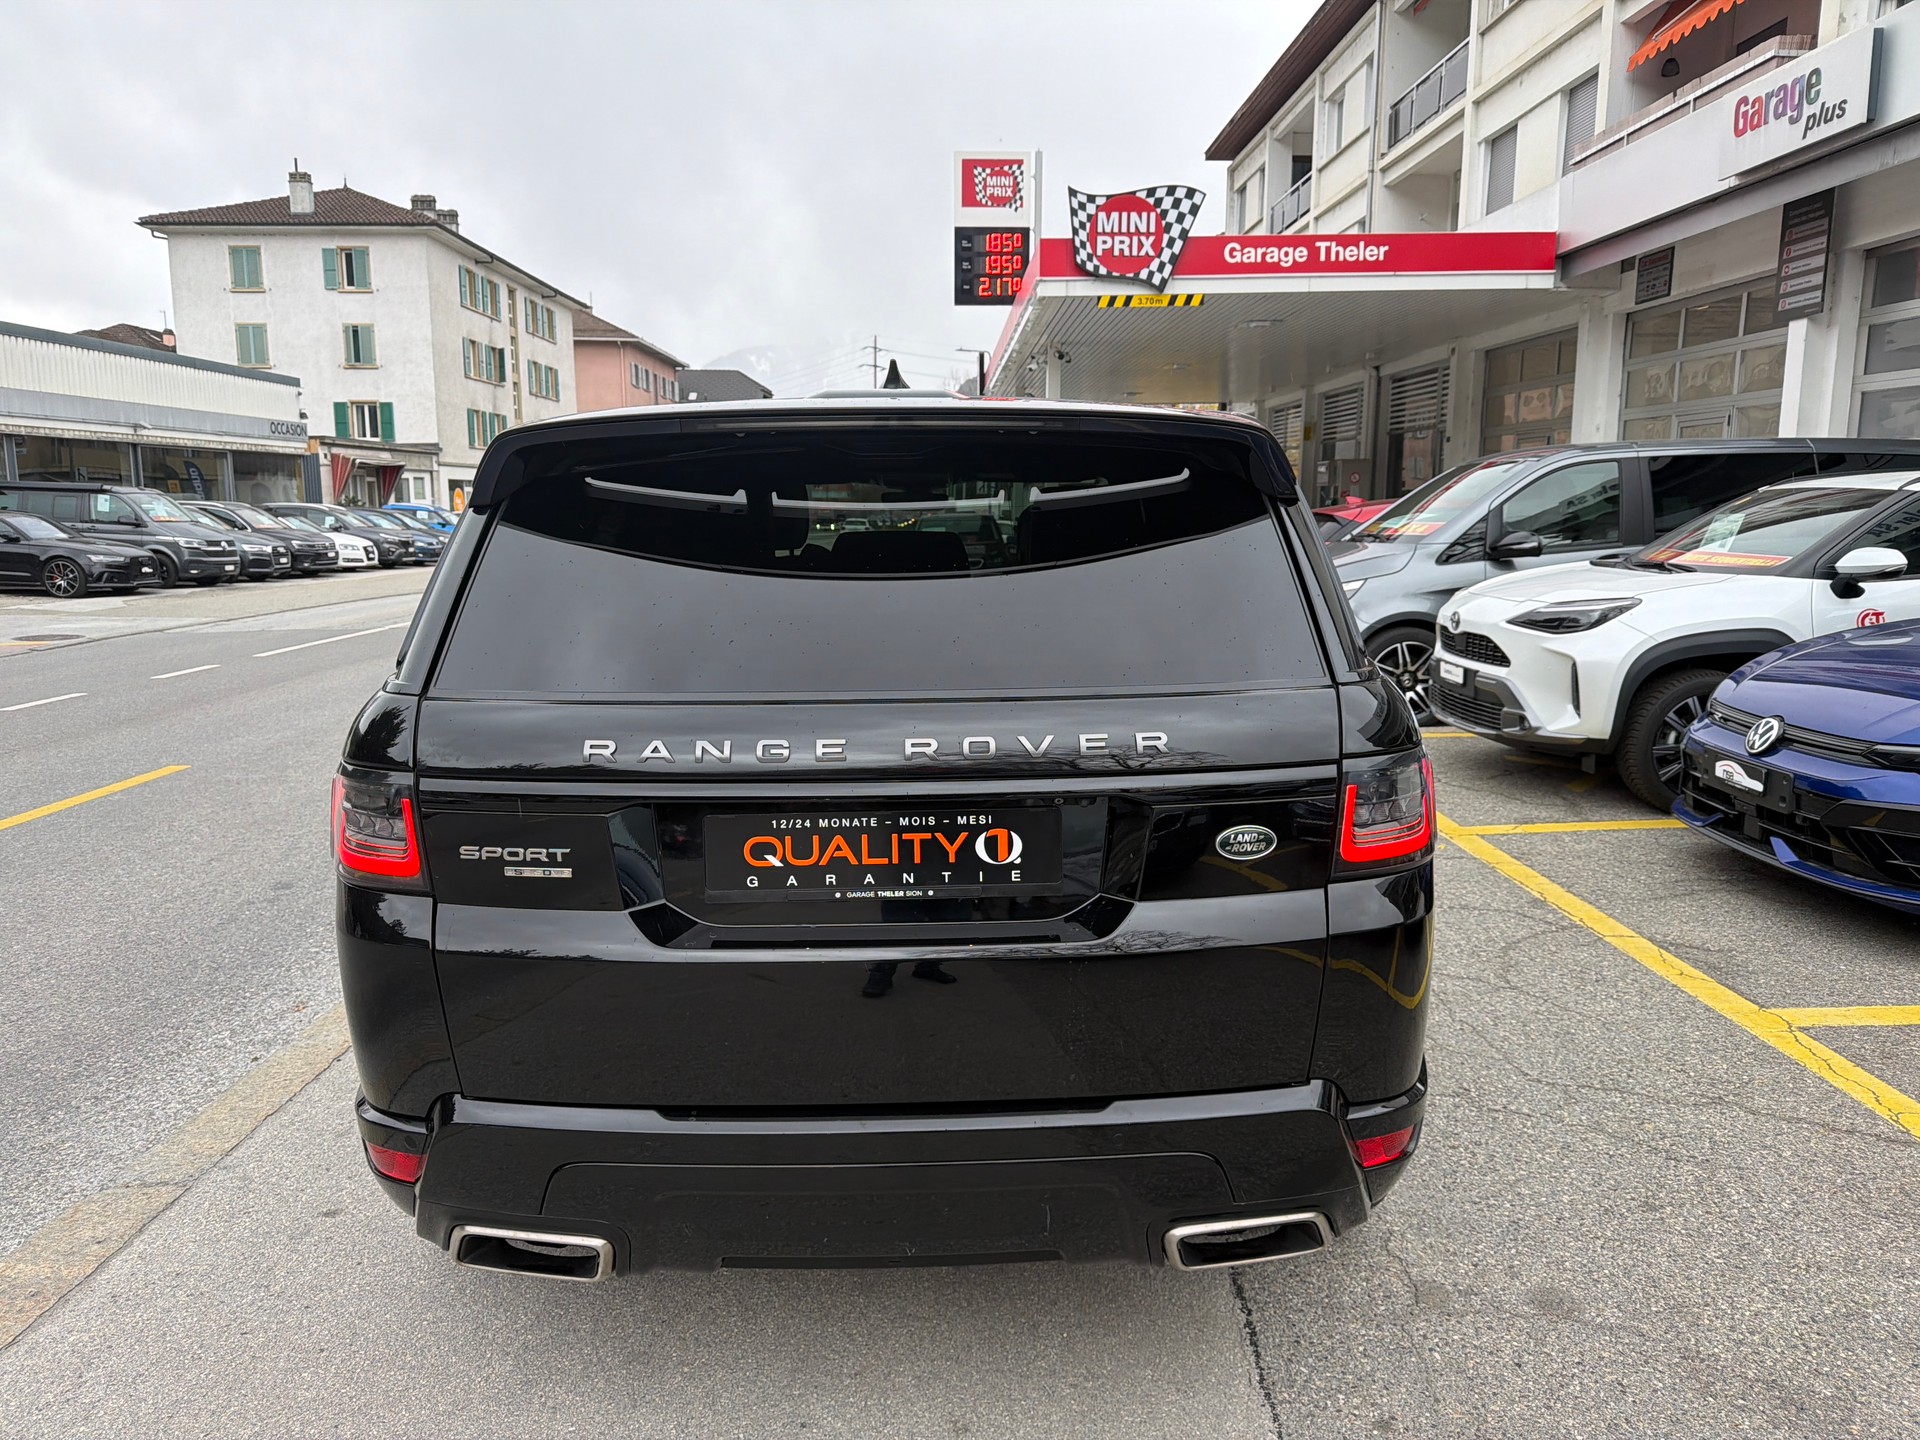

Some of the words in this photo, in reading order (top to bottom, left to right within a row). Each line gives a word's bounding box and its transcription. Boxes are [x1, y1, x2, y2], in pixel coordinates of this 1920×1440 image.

[1733, 67, 1822, 138] Garage
[1801, 99, 1848, 140] plus
[986, 175, 1014, 186] MINI
[986, 186, 1014, 197] PRIX
[1096, 211, 1157, 233] MINI
[1096, 235, 1156, 257] PRIX
[1223, 242, 1309, 268] Garage
[1314, 240, 1389, 262] Theler
[270, 421, 308, 437] OCCASION
[582, 738, 848, 764] RANGE
[904, 731, 1171, 761] ROVER
[771, 819, 811, 829] 12/24
[818, 817, 878, 828] MONATE
[899, 816, 936, 826] MOIS
[957, 815, 992, 825] MESI
[459, 845, 571, 862] SPORT
[743, 831, 969, 867] QUALITY
[1231, 841, 1267, 852] ROVER
[746, 870, 1021, 888] GARANTIE
[877, 890, 904, 898] THELER
